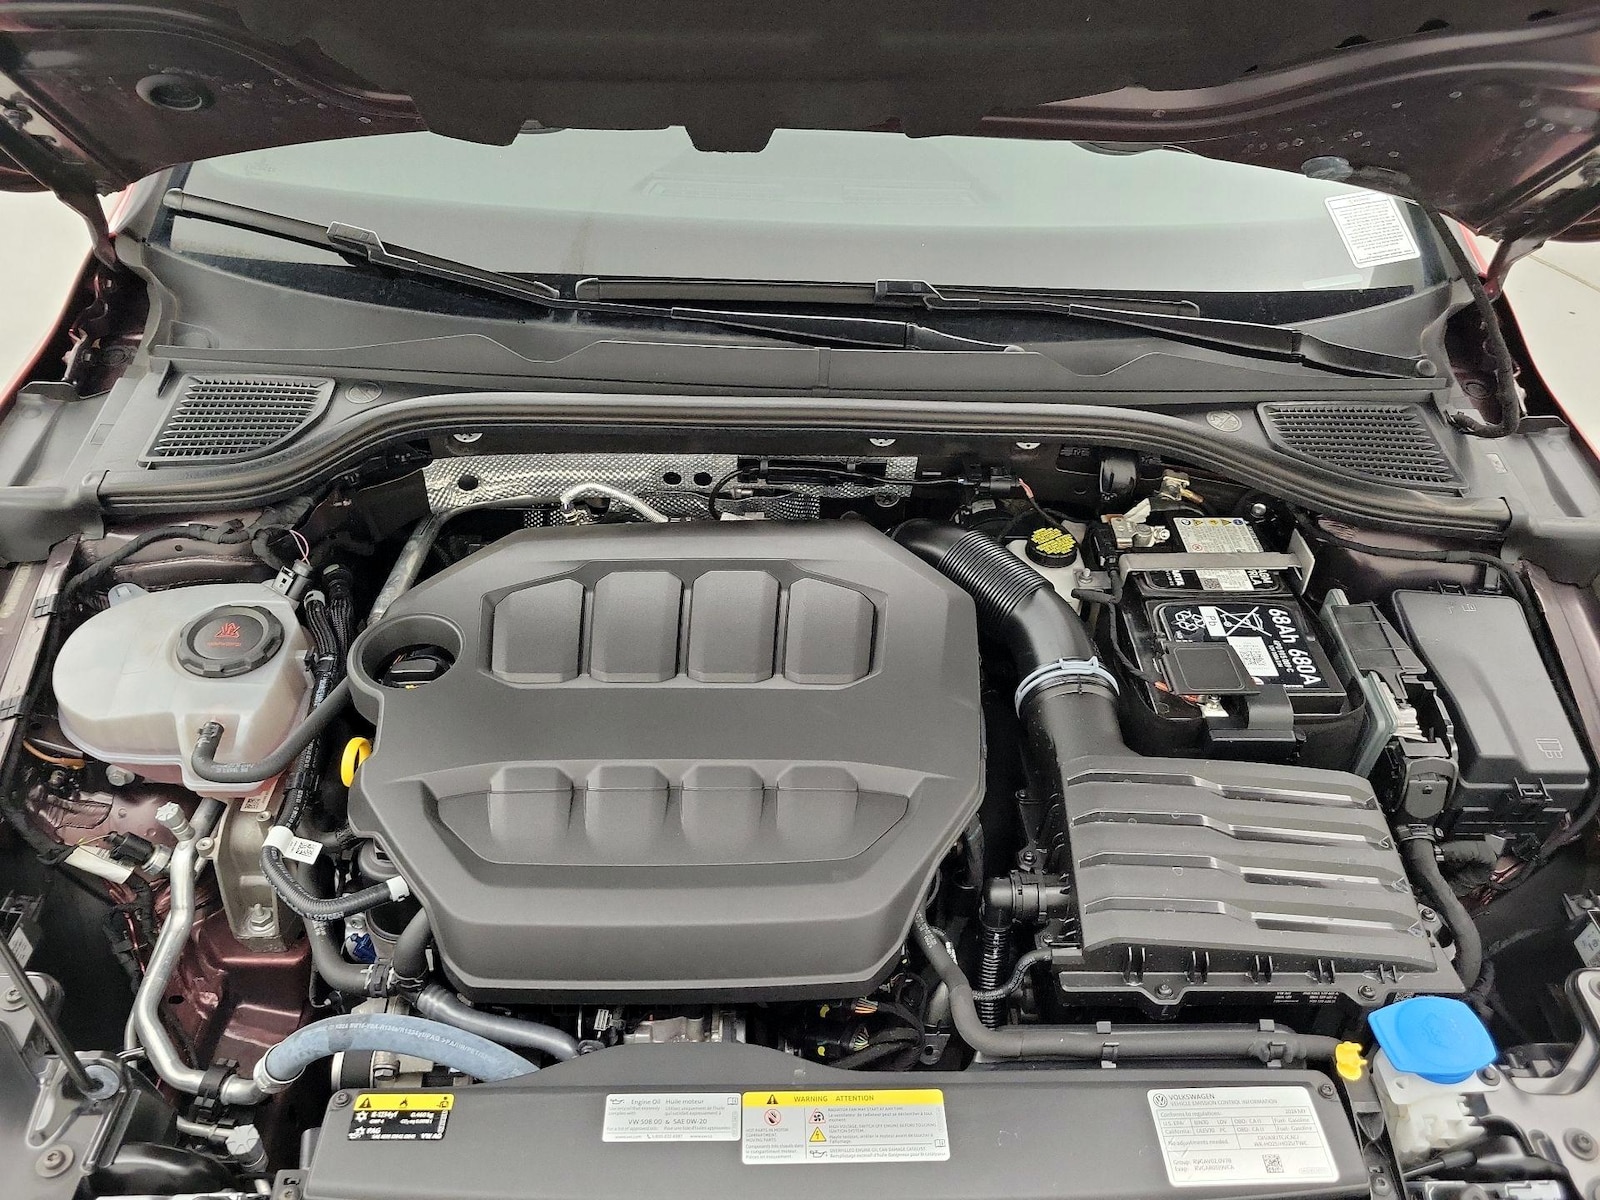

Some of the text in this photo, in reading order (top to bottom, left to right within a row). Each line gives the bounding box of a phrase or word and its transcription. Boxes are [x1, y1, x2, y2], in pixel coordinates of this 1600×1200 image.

[1205, 614, 1218, 627] Pb
[1268, 608, 1300, 644] 68Ah
[1287, 648, 1322, 685] 680A
[793, 1094, 875, 1103] WARNING ATTENTION
[1168, 1093, 1216, 1101] VOLKSWAGEN
[631, 1099, 651, 1107] Engine
